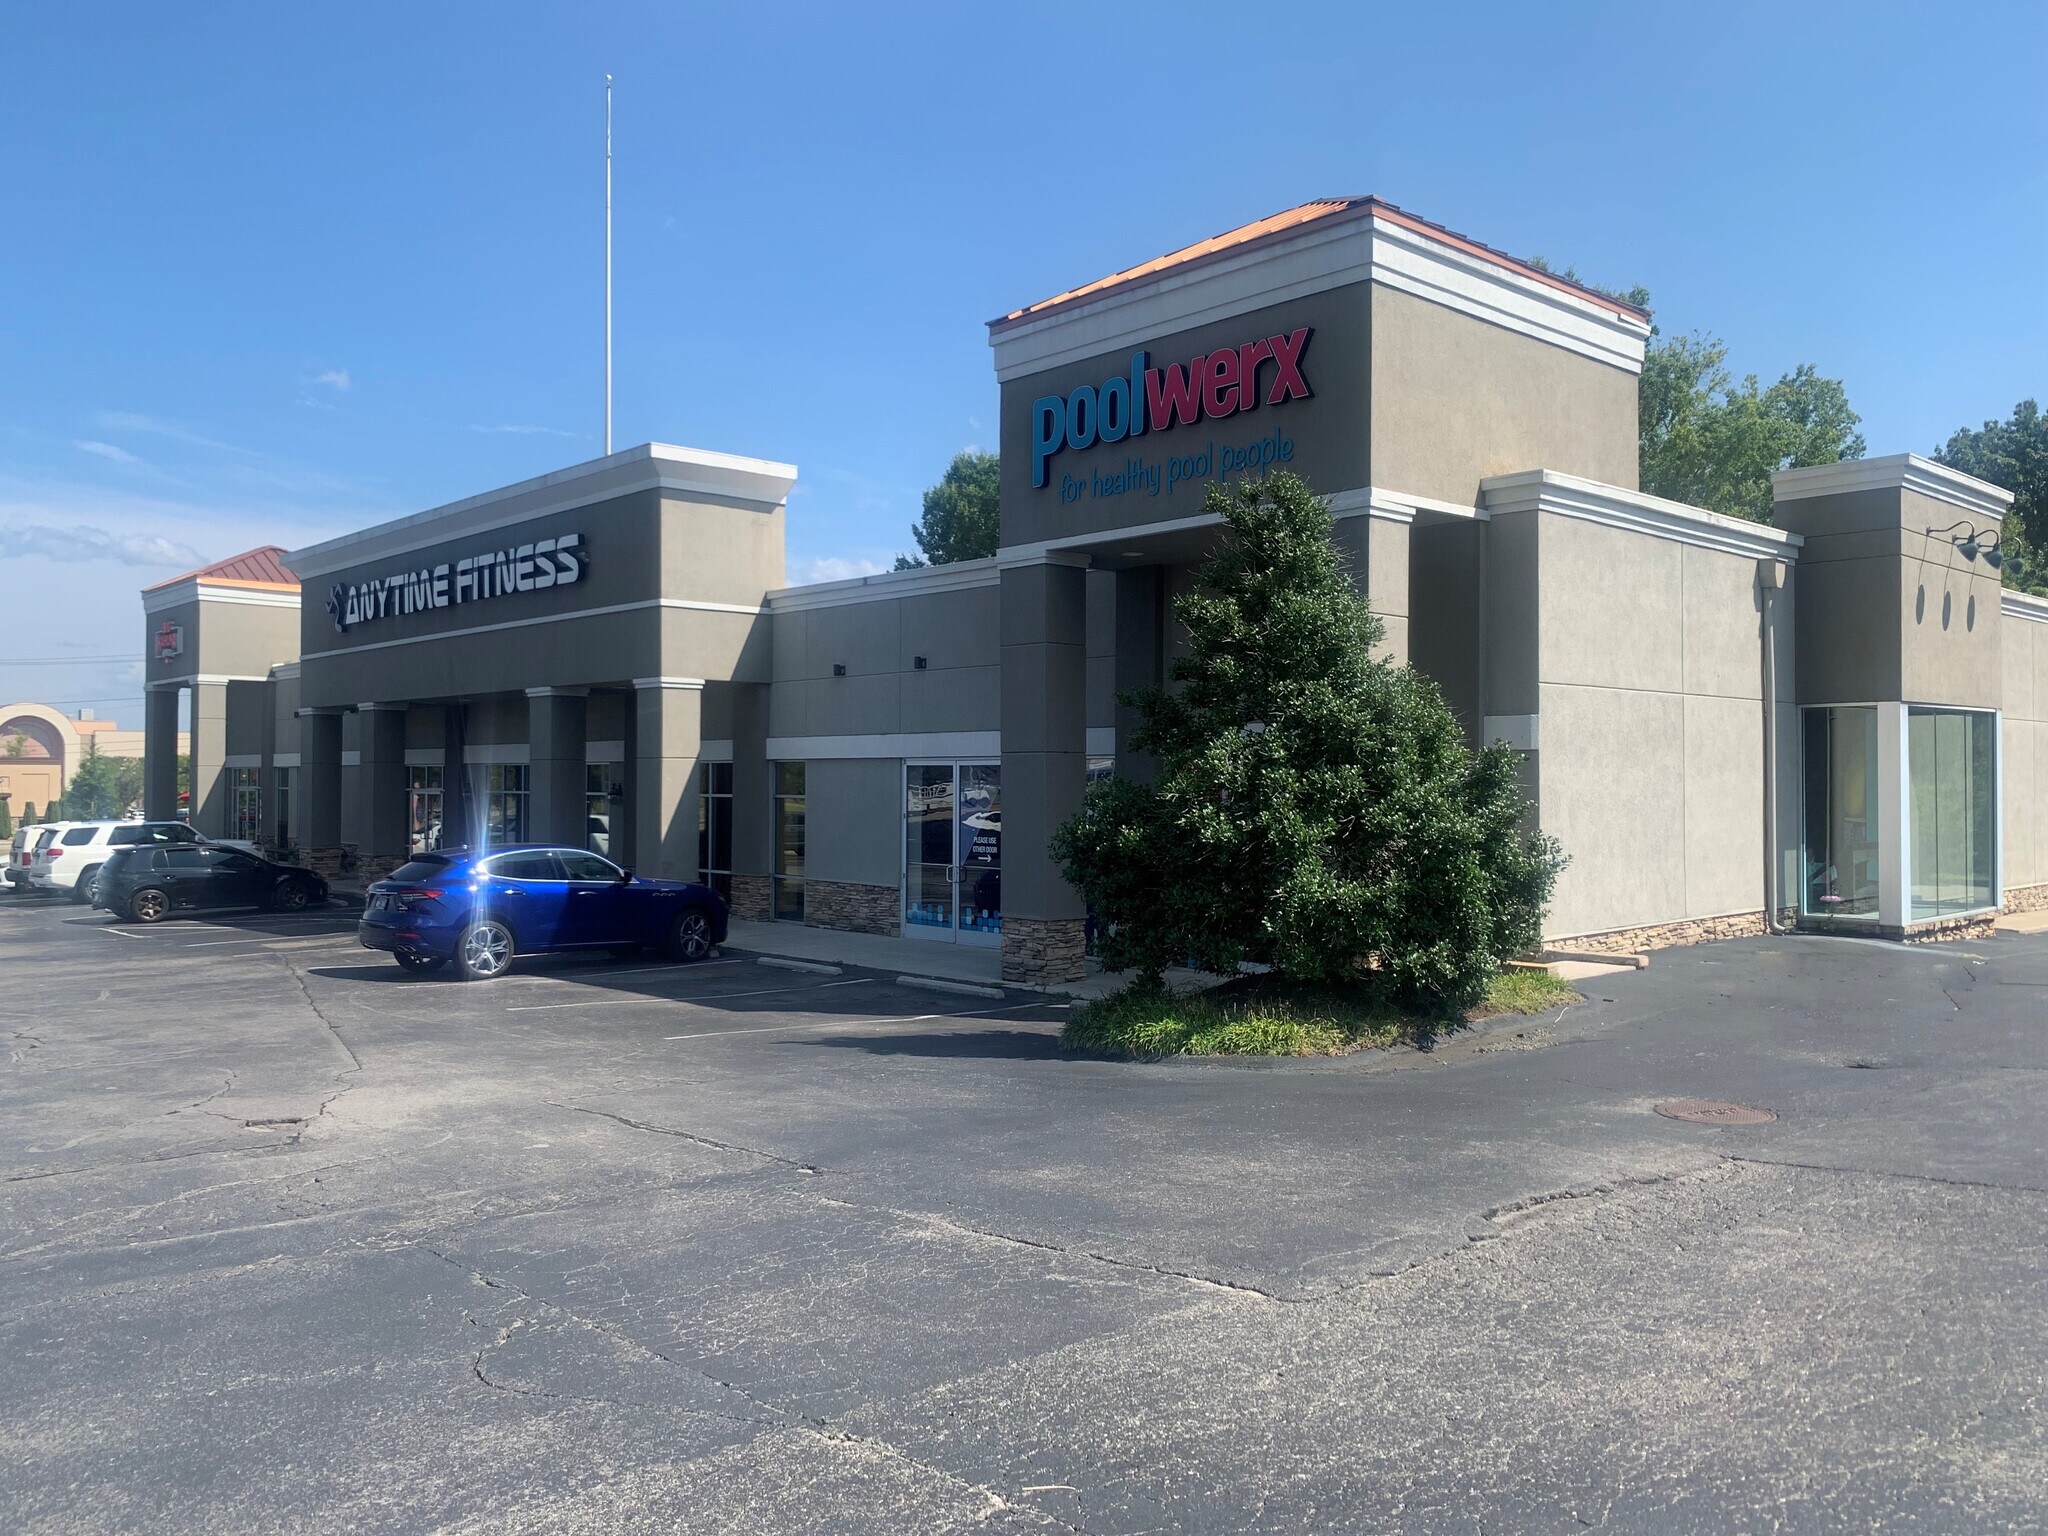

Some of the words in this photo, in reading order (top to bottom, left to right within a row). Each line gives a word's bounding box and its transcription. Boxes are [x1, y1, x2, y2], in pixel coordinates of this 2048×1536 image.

[1032, 327, 1315, 489] poolwerx
[1059, 473, 1086, 505] for
[1091, 453, 1161, 498] healthy
[1167, 441, 1213, 494] pool
[1219, 427, 1294, 480] people
[346, 564, 451, 625] ANYTIME
[456, 533, 583, 604] FITNESS
[973, 836, 988, 844] PLEASE
